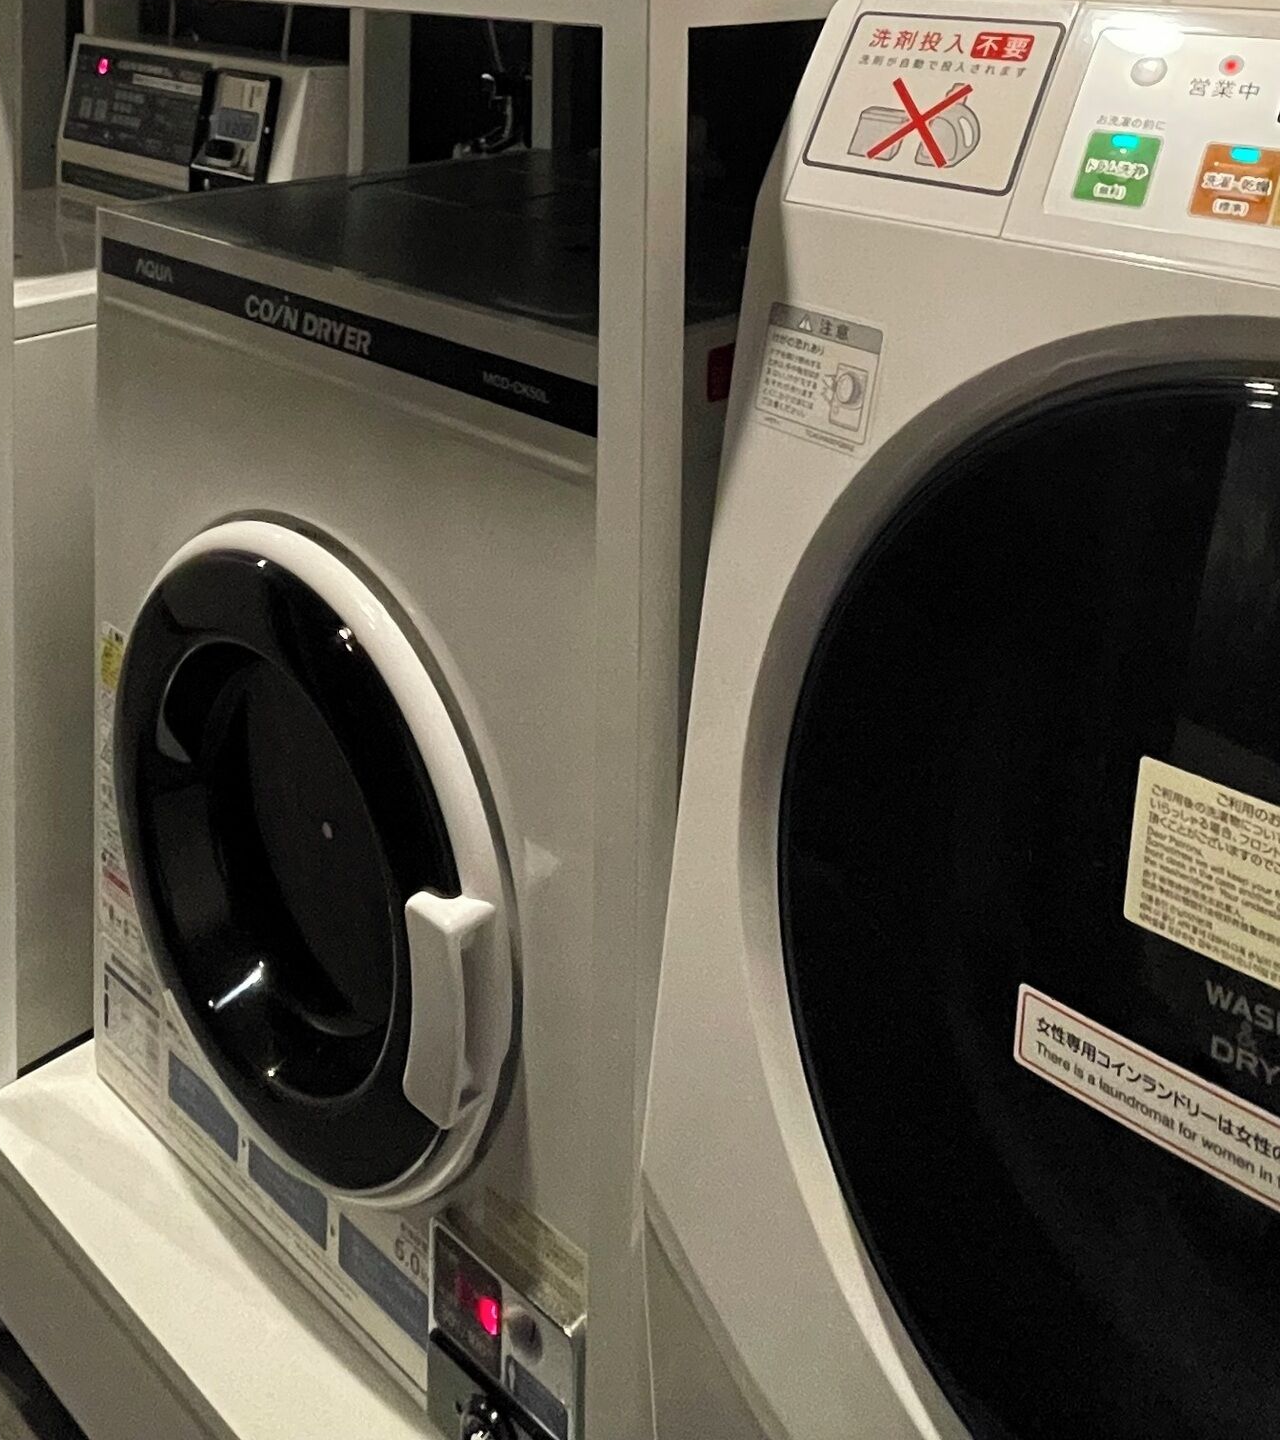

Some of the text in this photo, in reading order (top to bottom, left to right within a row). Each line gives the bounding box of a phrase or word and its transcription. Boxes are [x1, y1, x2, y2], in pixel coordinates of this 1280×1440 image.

[869, 28, 1031, 59] 洗剤投入 不要
[858, 54, 1027, 78] 洗剤が自動で投入されます
[1188, 77, 1261, 101] 営業中
[136, 259, 173, 283] AQUA
[303, 312, 371, 355] DRYER
[1034, 1039, 1071, 1073] There
[1098, 1076, 1175, 1132] laundromat
[1177, 1118, 1198, 1144] for
[1200, 1134, 1254, 1175] women
